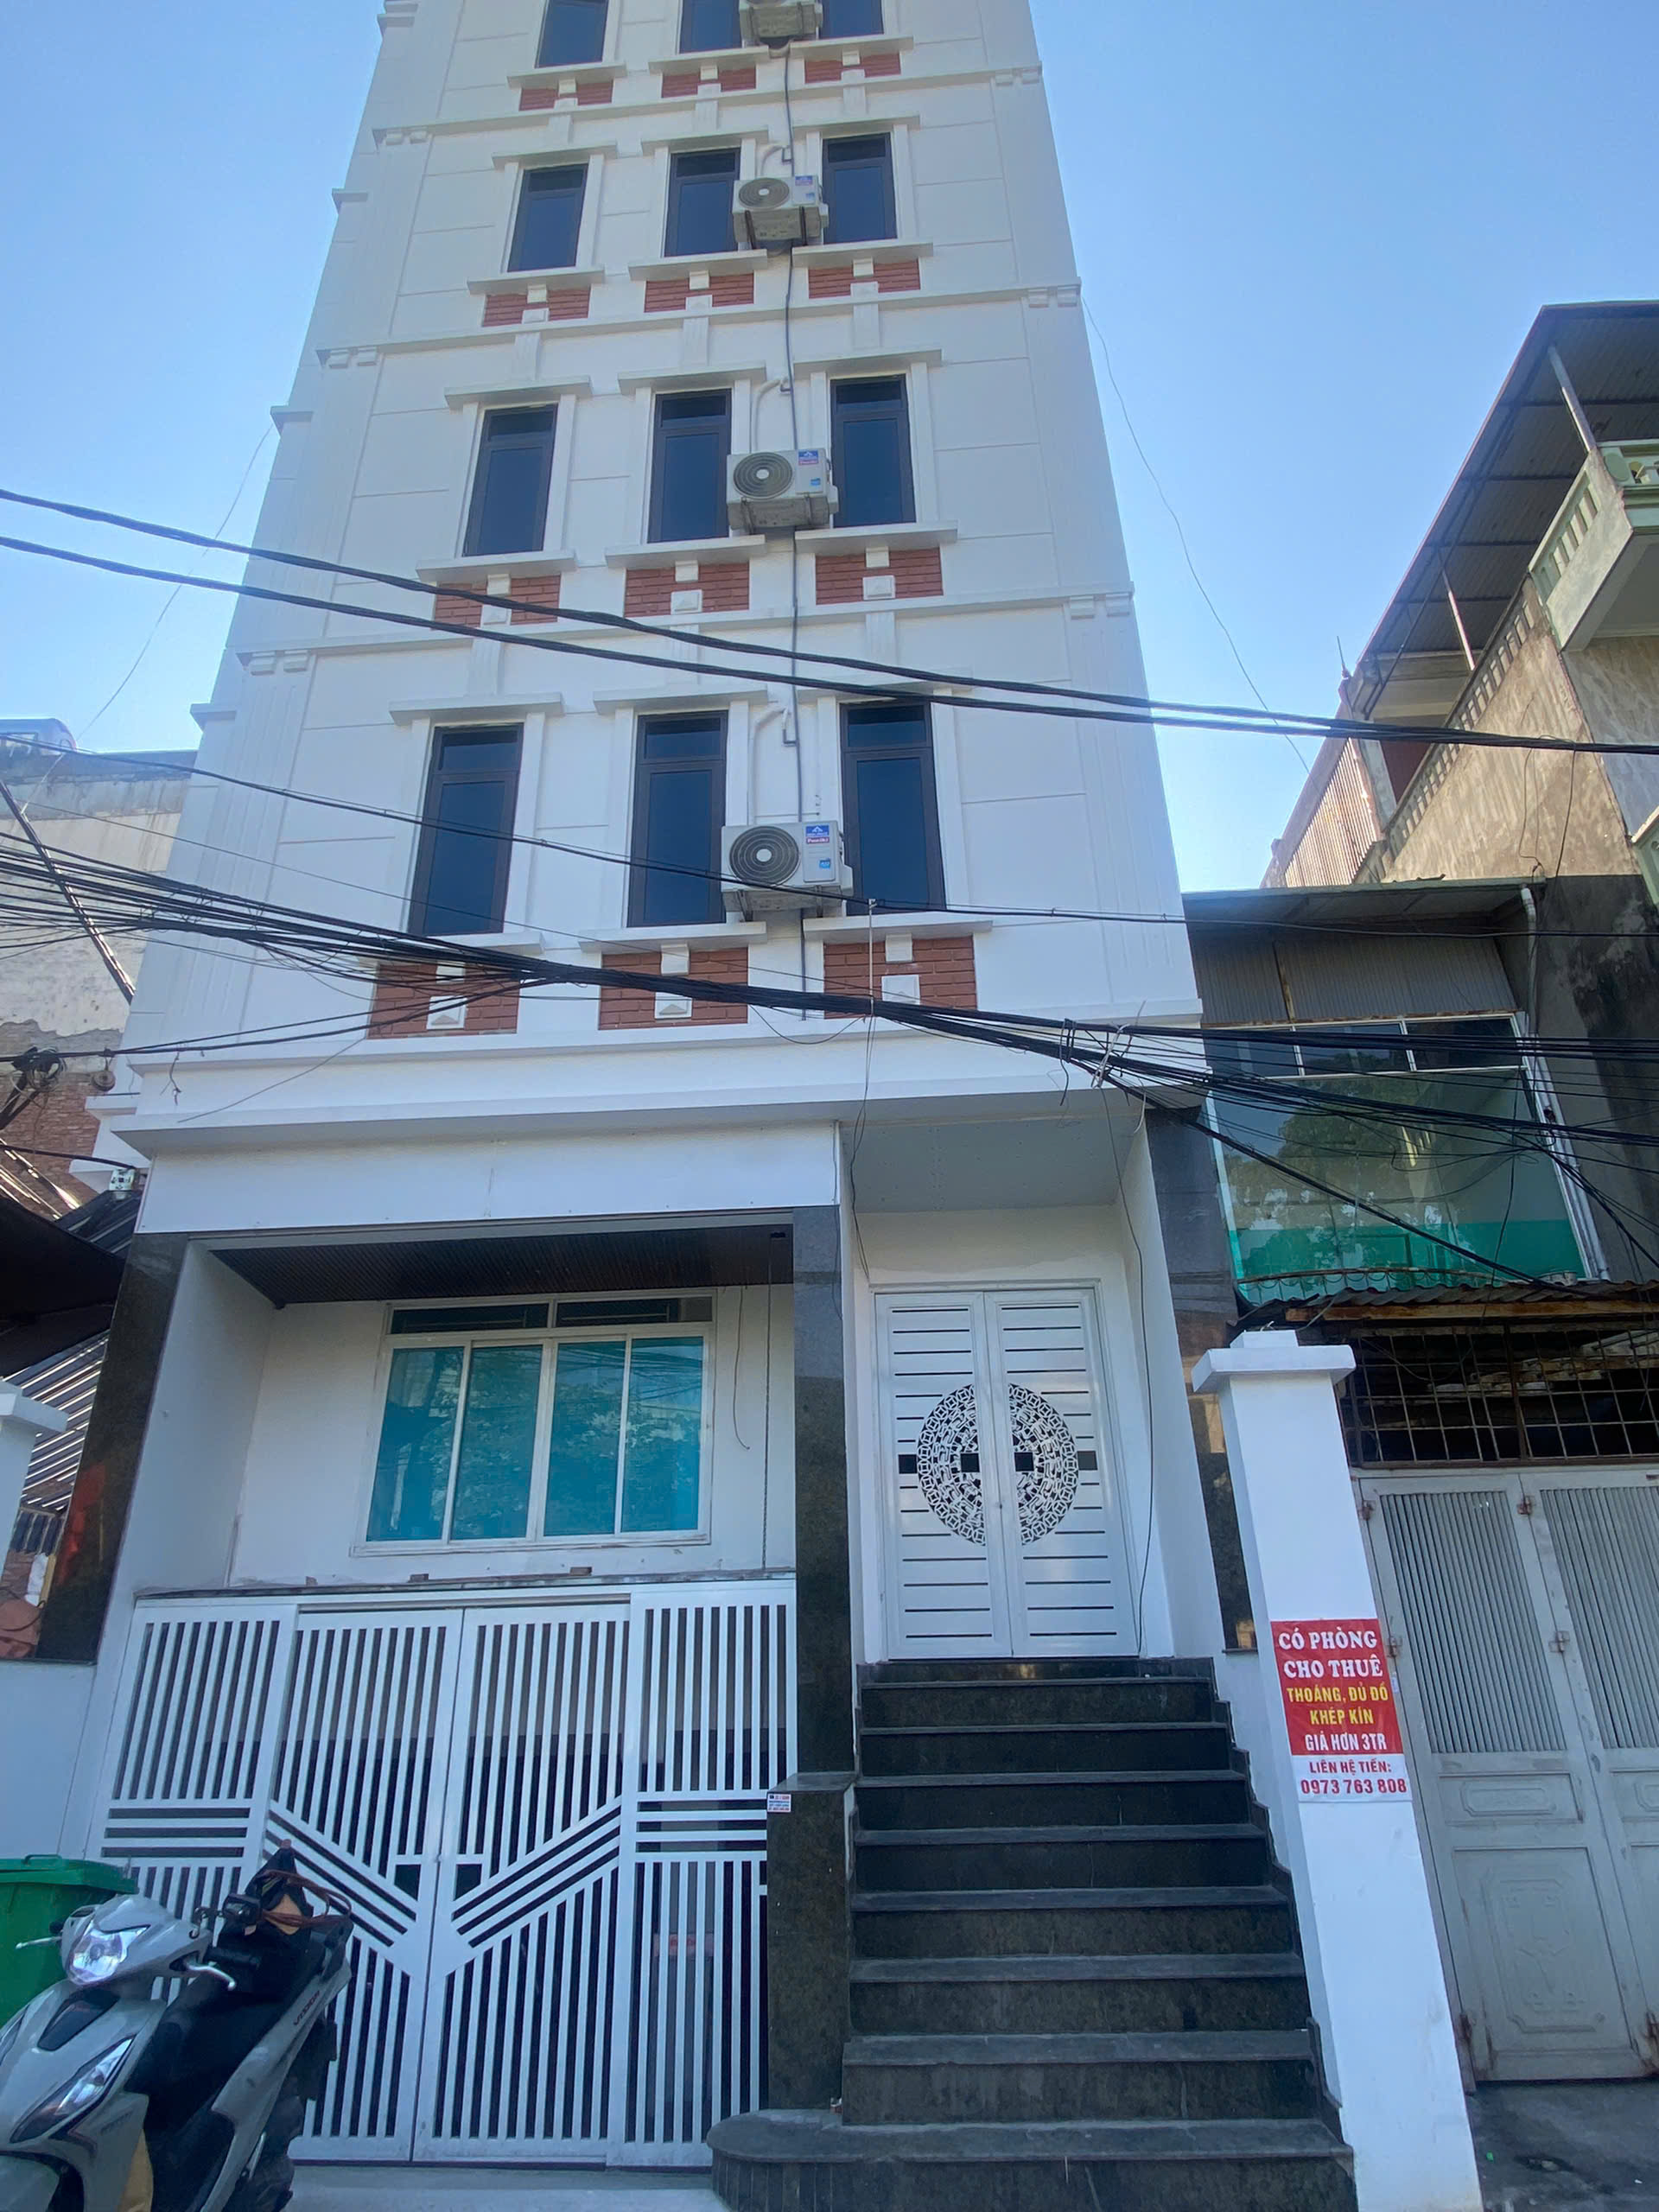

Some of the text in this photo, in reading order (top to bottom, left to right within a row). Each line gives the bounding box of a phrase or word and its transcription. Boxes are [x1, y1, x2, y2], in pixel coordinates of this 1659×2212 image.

[1278, 1627, 1376, 1649] CÓ PHÒNG
[1283, 1654, 1382, 1678] CHO THUÊ
[1348, 1681, 1367, 1701] ĐỦ
[1310, 1705, 1374, 1726] KHÉP KÍN
[1305, 1730, 1387, 1751] GIÁ HƠN 3TR
[1309, 1758, 1338, 1774] LIÊN
[1340, 1758, 1356, 1776] HỆ
[1300, 1778, 1407, 1795] 0973 763 808
